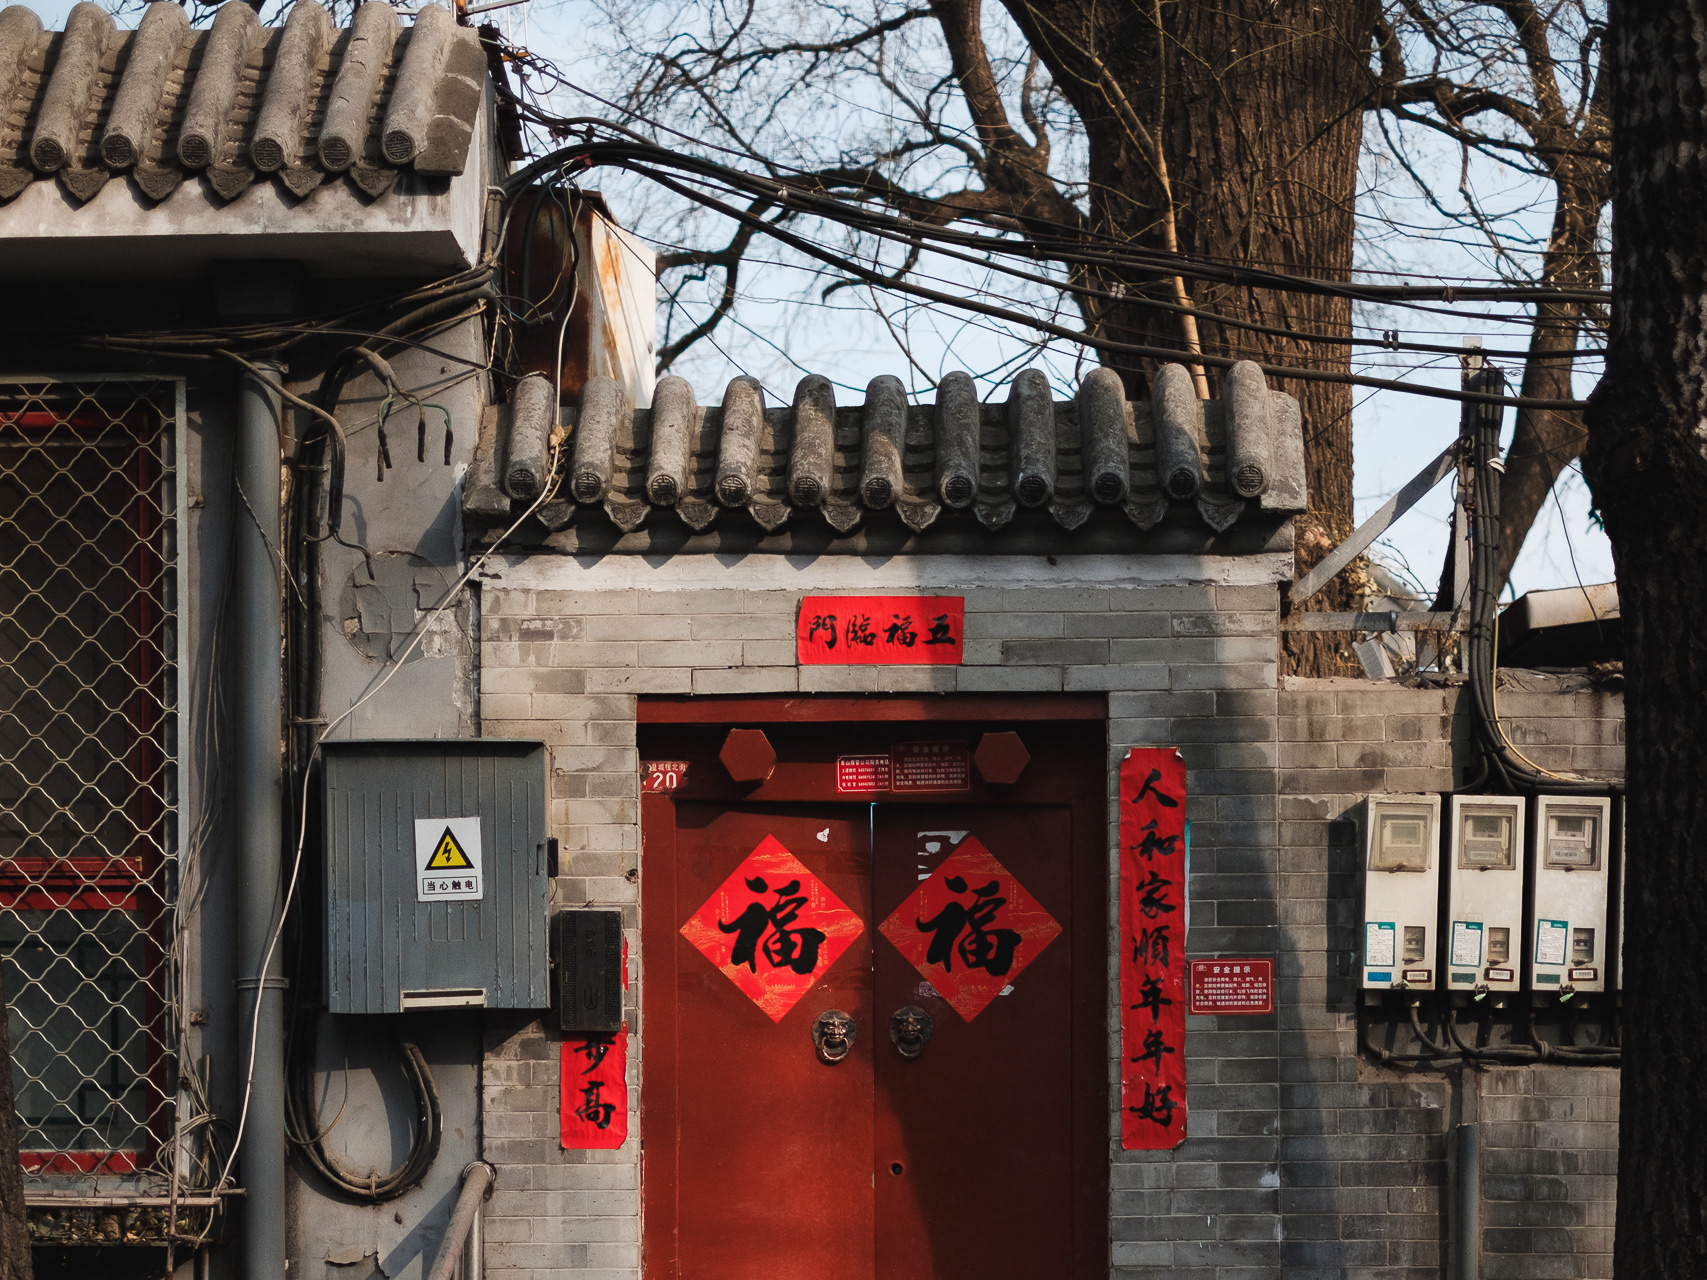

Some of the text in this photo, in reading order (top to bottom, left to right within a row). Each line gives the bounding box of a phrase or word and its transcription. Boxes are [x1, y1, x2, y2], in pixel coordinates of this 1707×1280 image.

[652, 772, 677, 790] 20
[426, 879, 475, 892] 当心触电
[718, 876, 826, 975] 福
[915, 875, 1023, 977] 福
[1213, 966, 1251, 974] 安全提示
